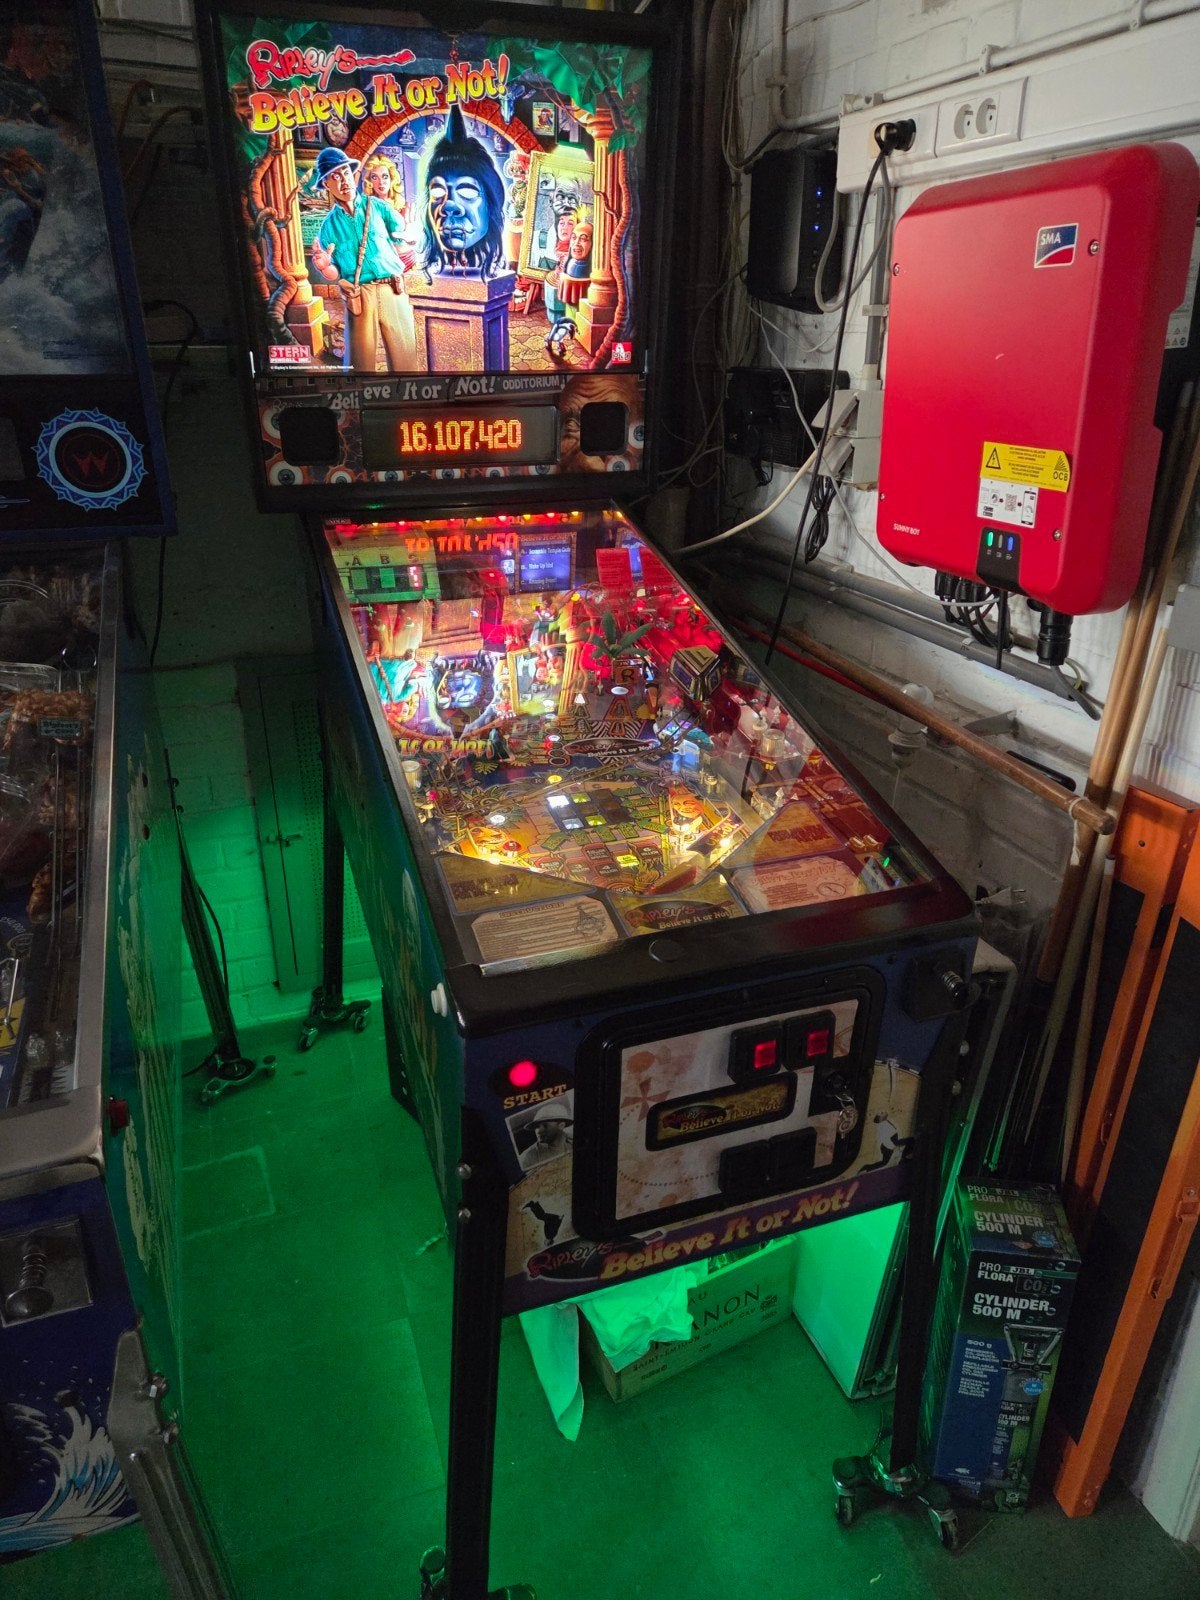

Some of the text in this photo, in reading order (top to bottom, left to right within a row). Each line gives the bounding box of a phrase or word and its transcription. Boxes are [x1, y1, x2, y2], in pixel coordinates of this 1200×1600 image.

[247, 40, 372, 90] Ripley's
[249, 54, 510, 133] Believe It or Not!
[1040, 232, 1061, 246] SMA
[270, 346, 309, 358] STERN
[422, 383, 441, 400] or
[503, 376, 560, 390] ODDITORIUM
[1053, 471, 1069, 481] OCB
[893, 523, 910, 533] SUNNY
[352, 557, 361, 565] A
[380, 555, 390, 565] B
[622, 669, 634, 681] R
[659, 919, 692, 929] Believe
[502, 1083, 567, 1109] START
[679, 1115, 724, 1133] Believe
[967, 1185, 988, 1195] PRO
[969, 1194, 1004, 1204] FLORA
[973, 1211, 1044, 1228] CYLINDER
[599, 1181, 859, 1281] Believe It or Not!
[976, 1221, 1022, 1235] 500 M
[527, 1239, 615, 1278] Ripley's
[979, 1261, 1001, 1272] PRO
[977, 1270, 1014, 1283] FLORA
[973, 1292, 1050, 1312] CYLINDER
[972, 1304, 1021, 1320] 500 M
